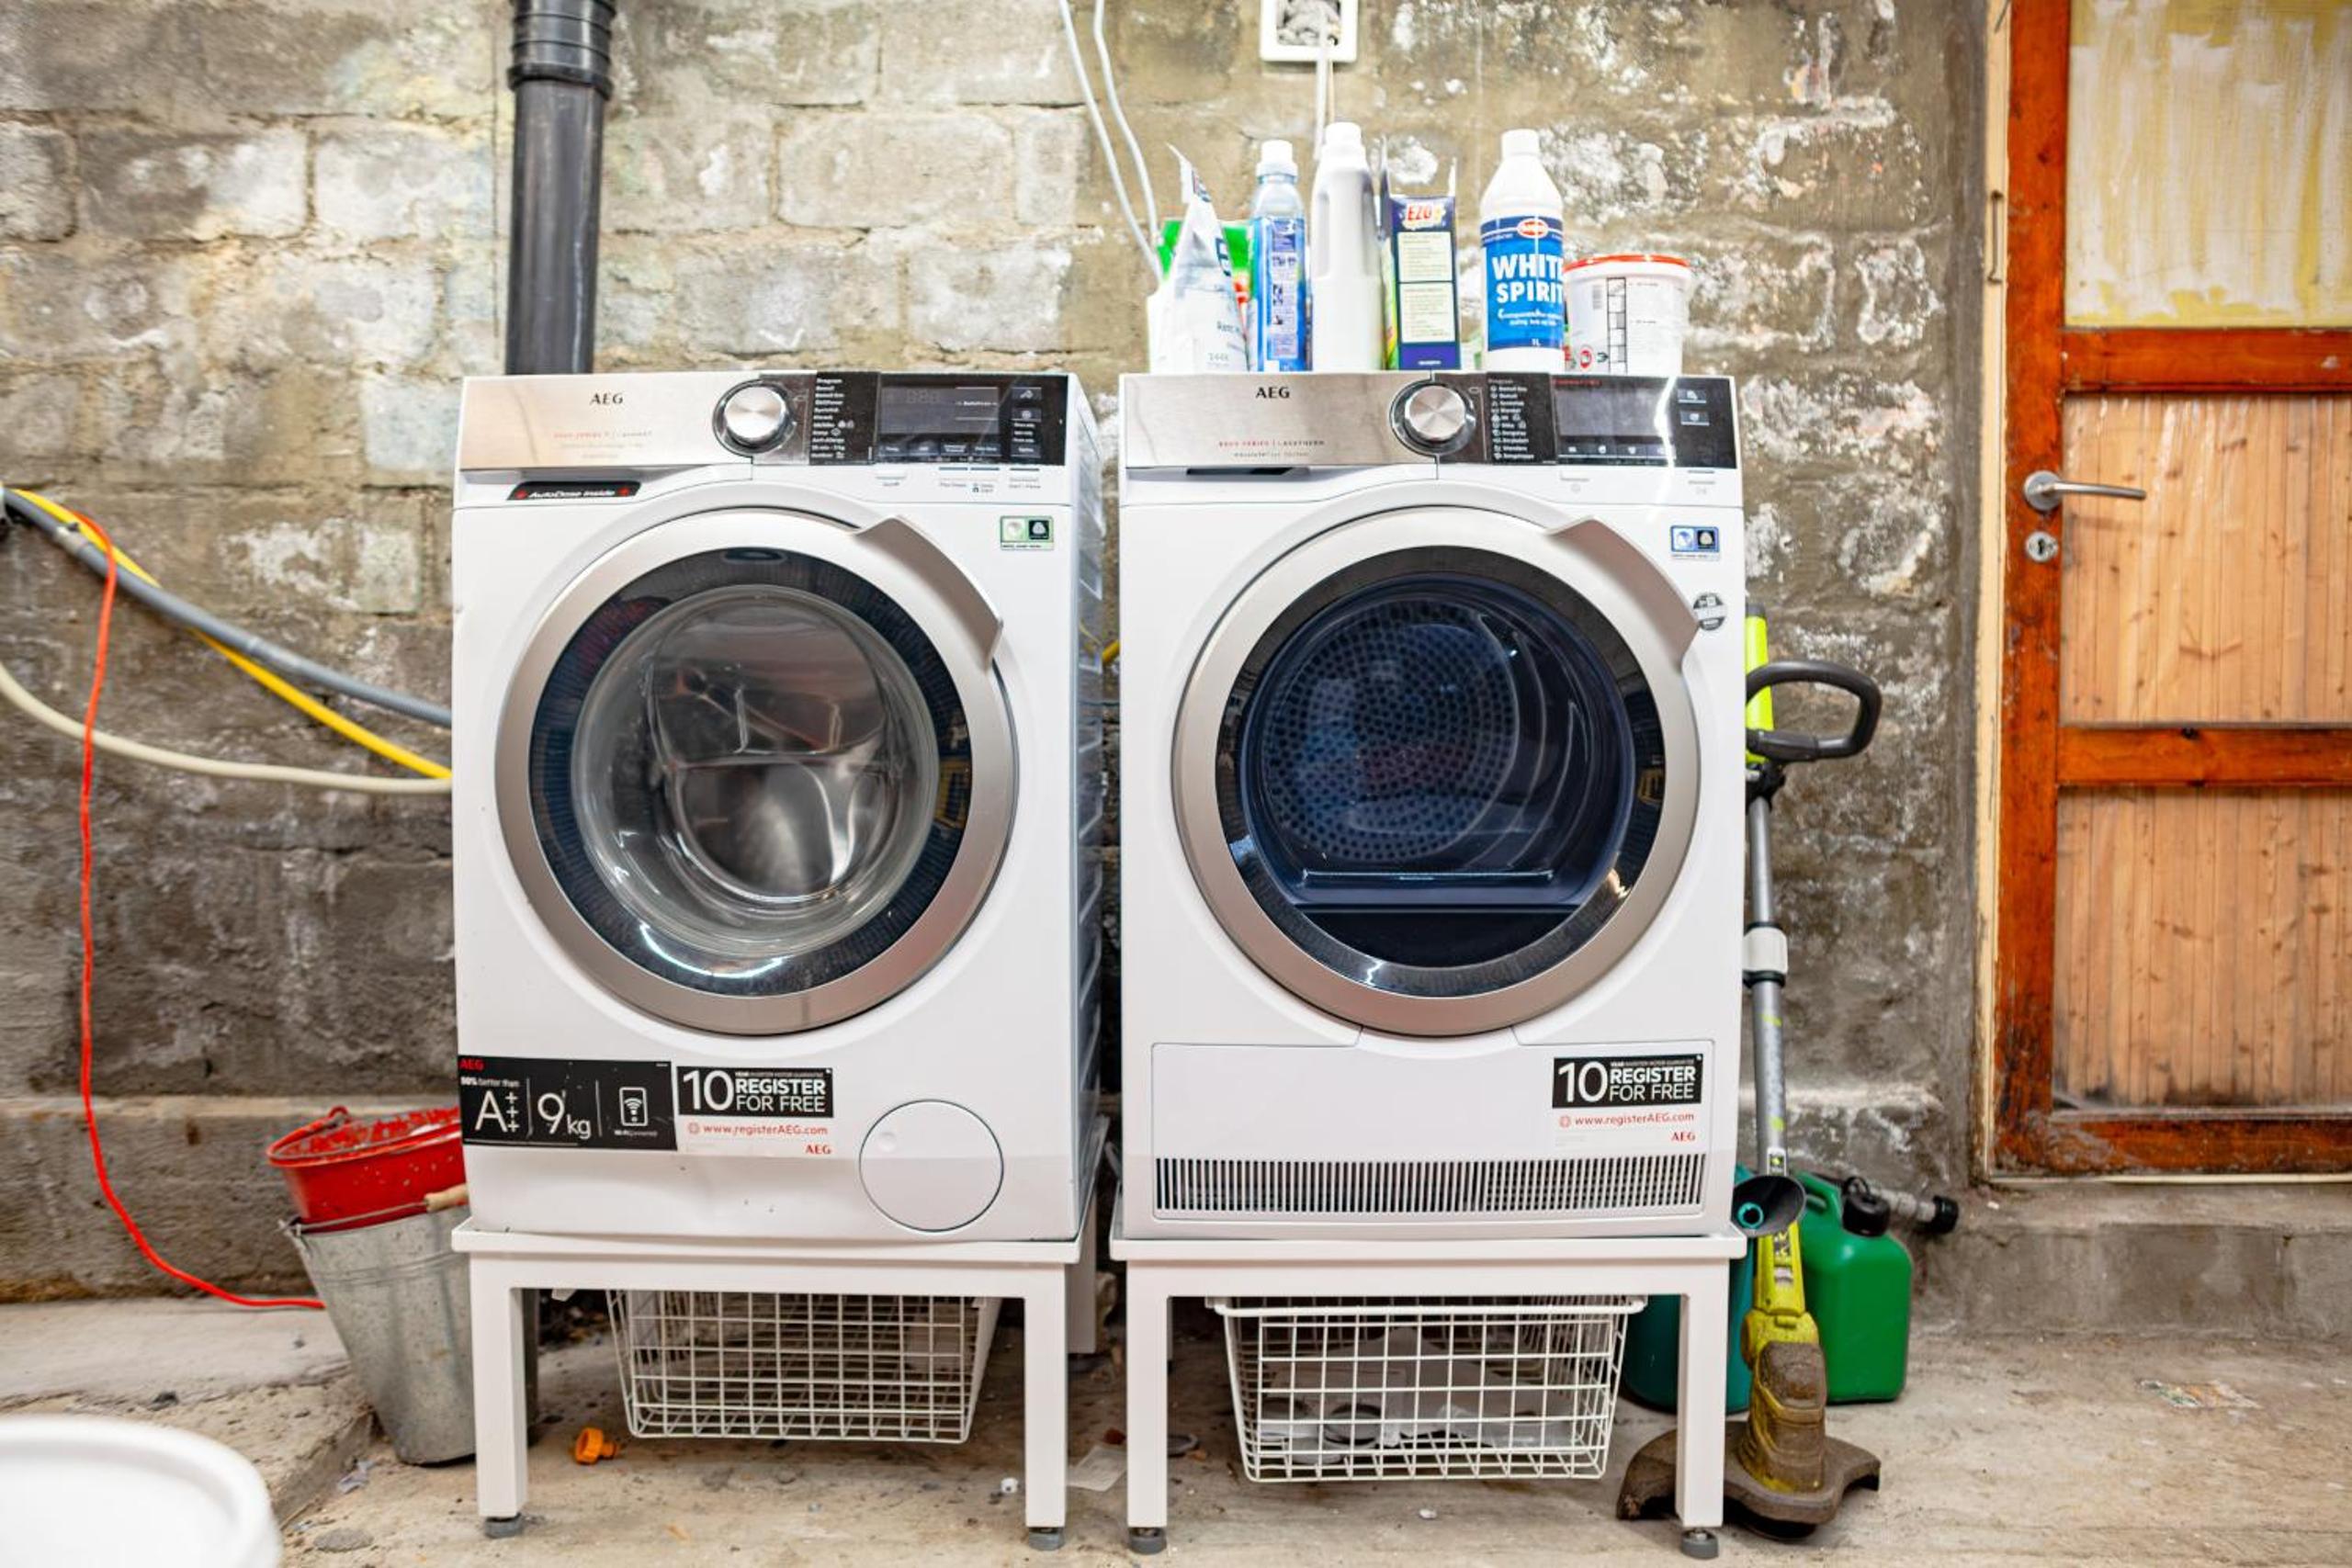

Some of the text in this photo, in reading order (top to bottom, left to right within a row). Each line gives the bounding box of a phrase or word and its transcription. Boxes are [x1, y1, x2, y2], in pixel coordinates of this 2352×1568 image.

[1492, 253, 1564, 281] WHITE
[589, 392, 625, 406] AEG
[1255, 386, 1291, 400] AEG
[460, 1058, 484, 1070] AEG
[1558, 1060, 1609, 1103] 10
[1610, 1066, 1697, 1085] REGISTER
[683, 1069, 735, 1111] 10
[735, 1077, 827, 1096] REGISTER
[1609, 1082, 1695, 1102] FOR FREE
[736, 1095, 826, 1112] FOR FREE
[1575, 1113, 1694, 1126] www.registerAEG.com
[703, 1123, 829, 1136] www.registerAEG.com
[1670, 1131, 1696, 1142] AEG
[805, 1145, 831, 1156] AEG
